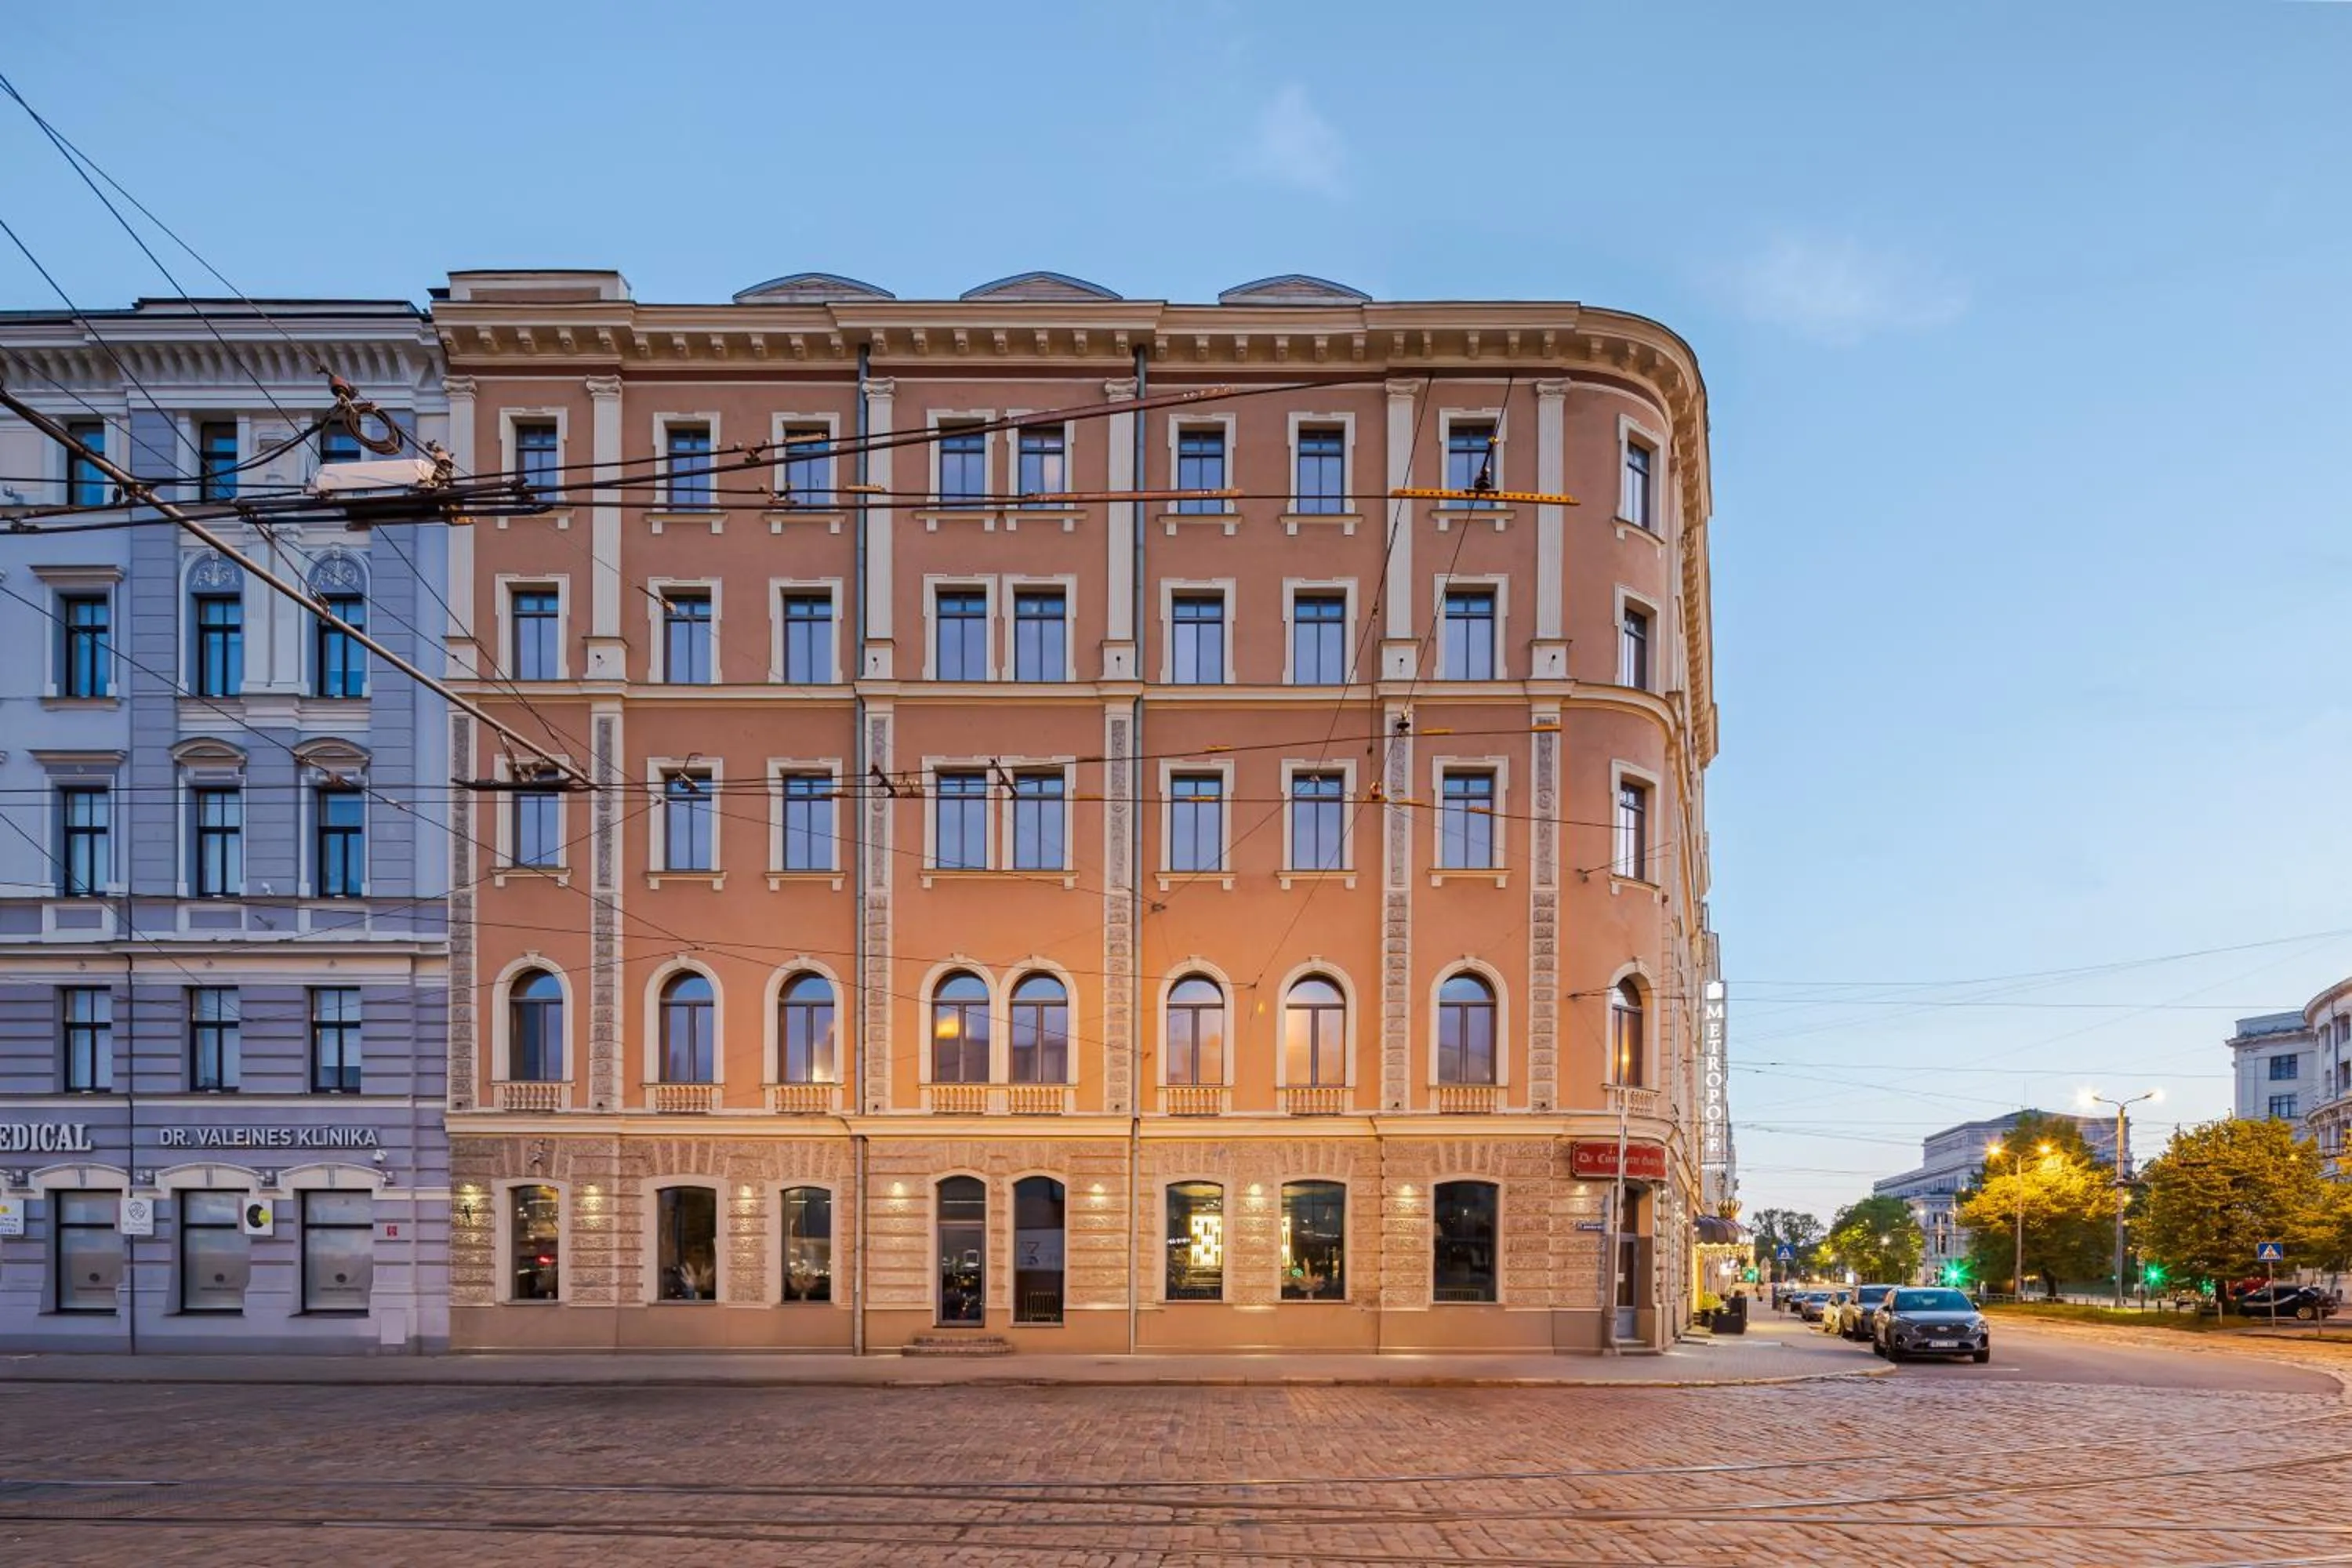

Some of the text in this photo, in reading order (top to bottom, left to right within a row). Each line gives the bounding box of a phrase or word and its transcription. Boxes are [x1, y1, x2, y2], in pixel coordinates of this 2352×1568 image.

[1705, 1004, 1724, 1152] METROPOLE
[159, 1125, 378, 1146] DR. VALEINES KLĪNIKA
